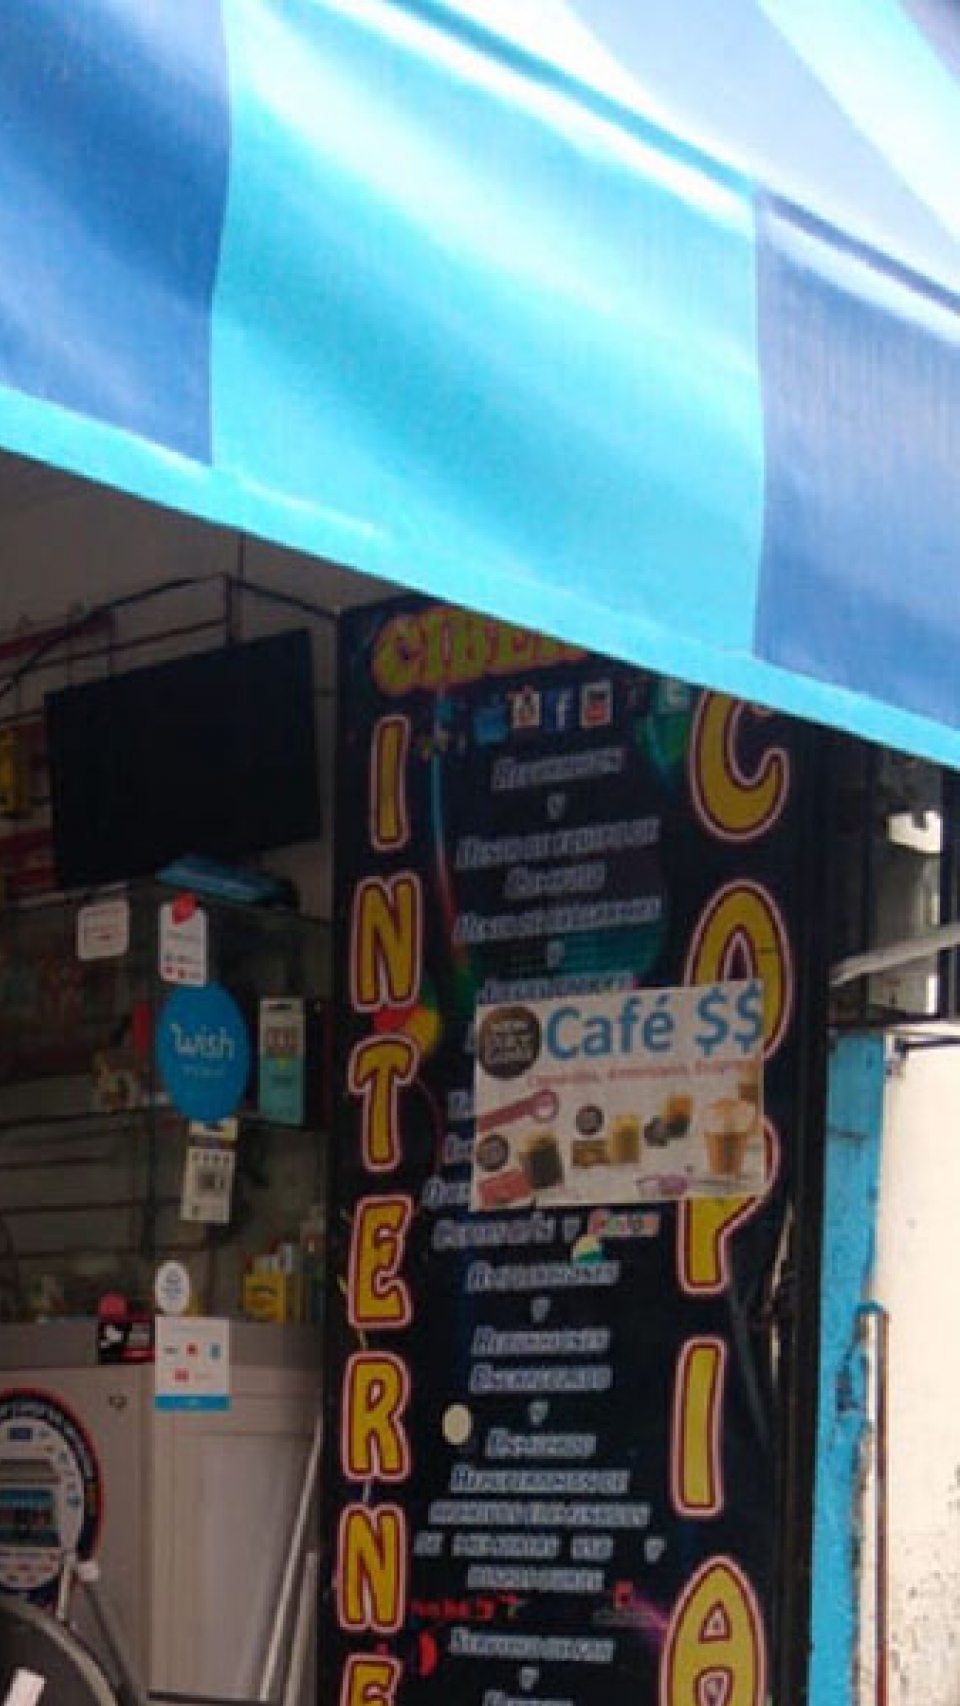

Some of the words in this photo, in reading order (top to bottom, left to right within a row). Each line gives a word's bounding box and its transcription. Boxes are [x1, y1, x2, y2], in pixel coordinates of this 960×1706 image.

[371, 606, 588, 697] CIBE
[546, 994, 675, 1060] Café
[695, 982, 763, 1057] $$
